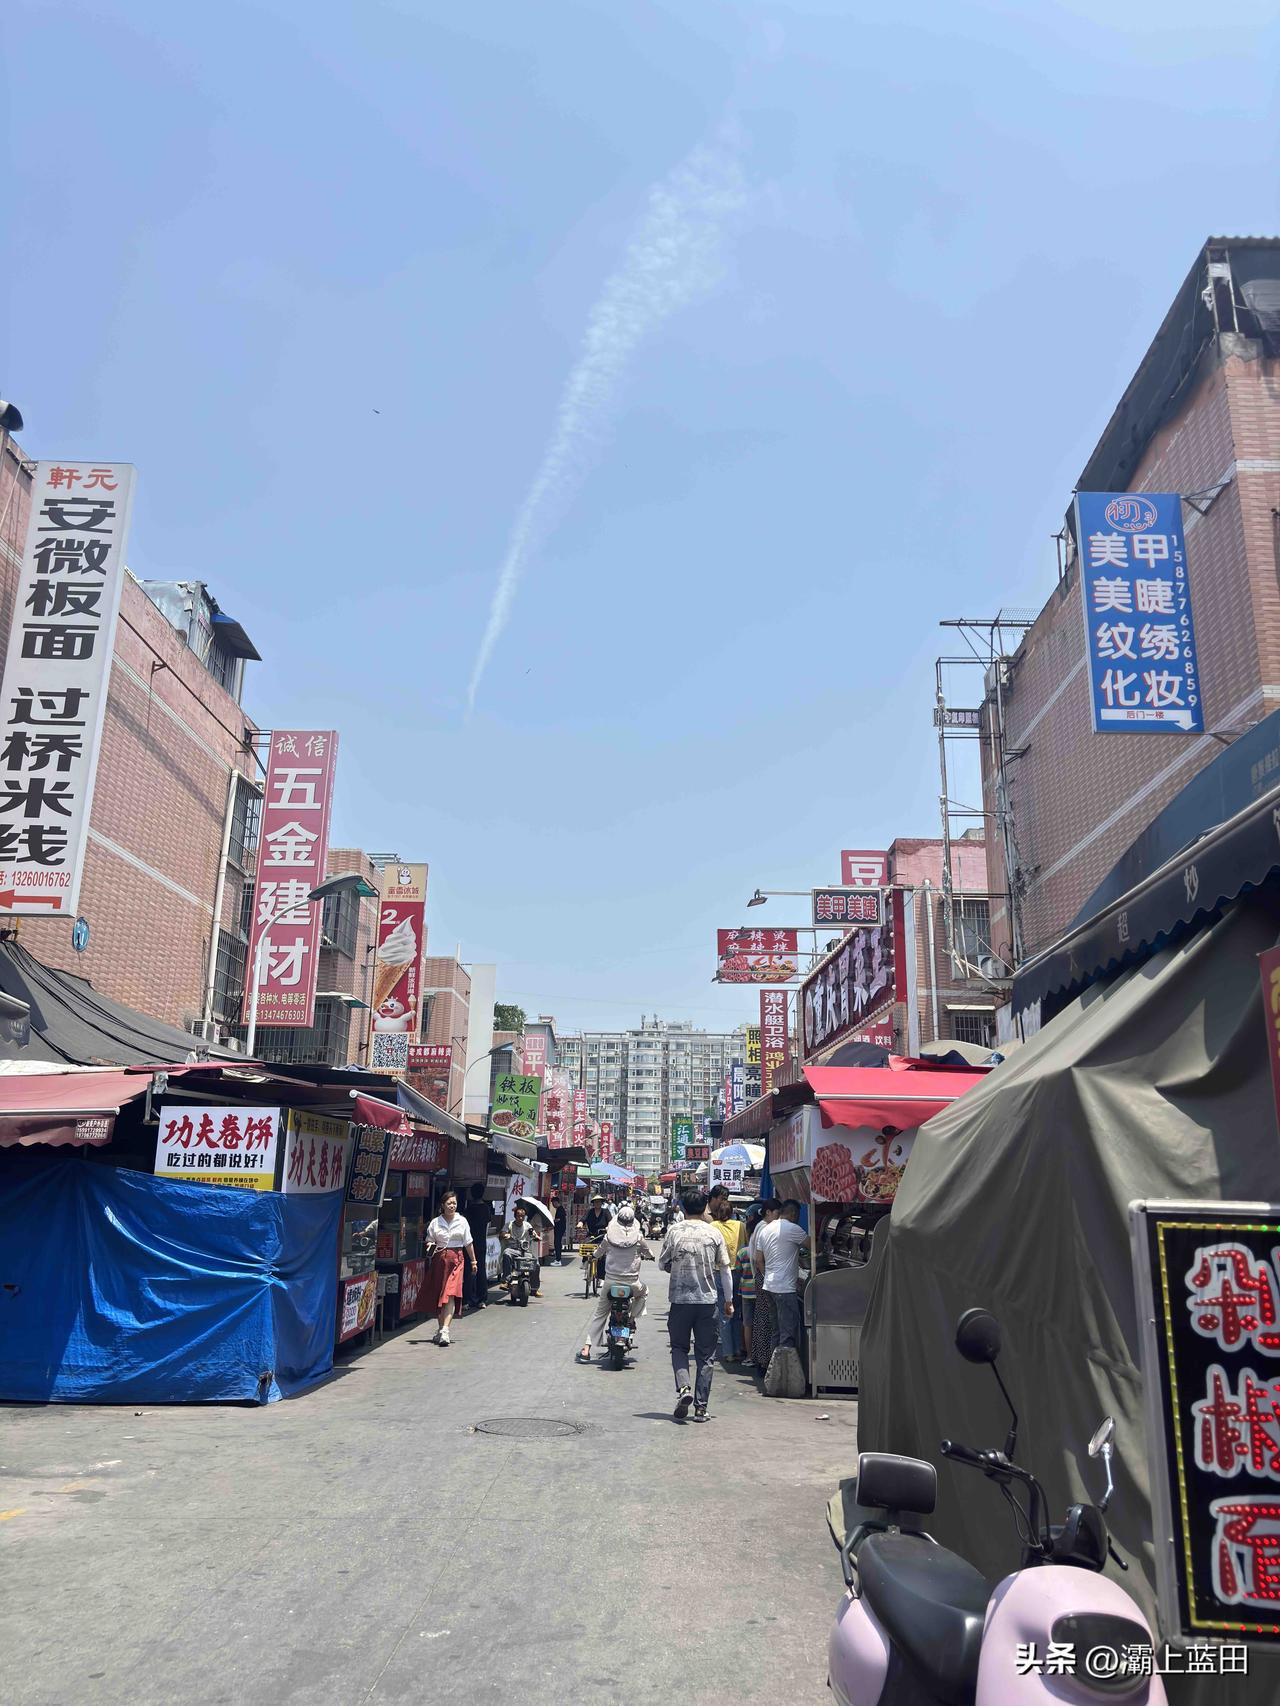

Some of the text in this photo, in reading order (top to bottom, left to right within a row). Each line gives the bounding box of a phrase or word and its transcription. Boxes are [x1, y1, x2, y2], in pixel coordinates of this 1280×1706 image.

[1089, 531, 1169, 568] 美甲
[1093, 576, 1177, 614] 美睫
[1171, 534, 1198, 706] 15877626859
[1097, 622, 1180, 660] 纹绣
[1101, 669, 1186, 708] 化妆
[1126, 710, 1164, 719] 后门一楼
[275, 734, 328, 758] 诚信
[0, 687, 90, 866] 过桥米线
[12, 871, 71, 887] 13260016762
[252, 767, 322, 986] 五金建材
[848, 856, 884, 887] 豆
[1184, 865, 1199, 903] 炒
[381, 909, 397, 925] 2
[817, 894, 877, 920] 美甲美睫
[765, 992, 784, 1049] 潜水艇卫浴
[875, 1036, 892, 1045] 饮料
[500, 1077, 536, 1094] 铁板
[162, 1113, 273, 1150] 功夫卷饼
[512, 1108, 536, 1121] 炒面
[167, 1153, 264, 1168] 吃过的都说好!
[288, 1138, 343, 1189] 功夫卷饼
[351, 1129, 385, 1200] 螺蛳粉
[687, 1147, 709, 1159] 臭豆腐
[713, 1169, 742, 1181] 臭豆腐
